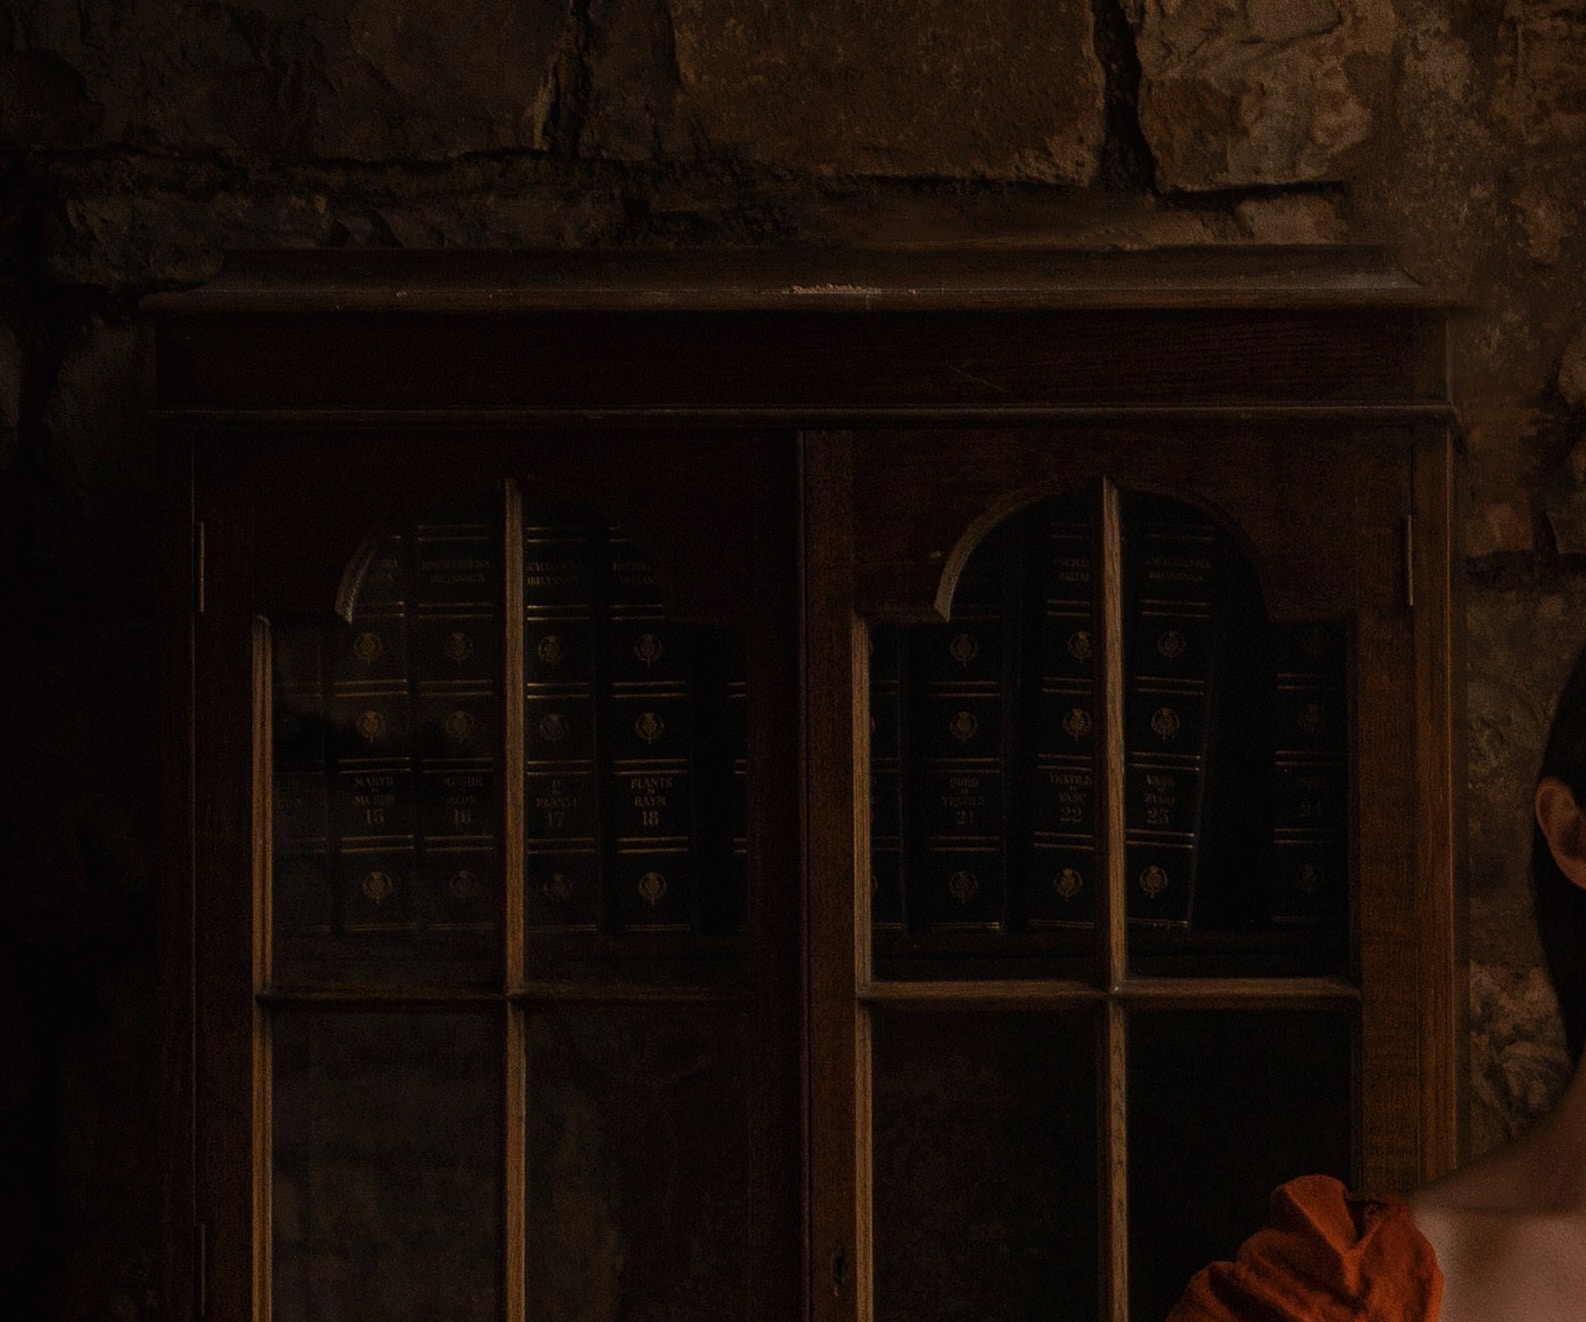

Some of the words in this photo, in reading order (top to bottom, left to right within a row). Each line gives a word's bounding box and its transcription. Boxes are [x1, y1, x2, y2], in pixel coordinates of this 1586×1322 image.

[366, 808, 385, 825] 15
[548, 811, 565, 827] 17
[642, 810, 660, 827] 18
[956, 809, 975, 825] 21
[1060, 806, 1082, 823] 22
